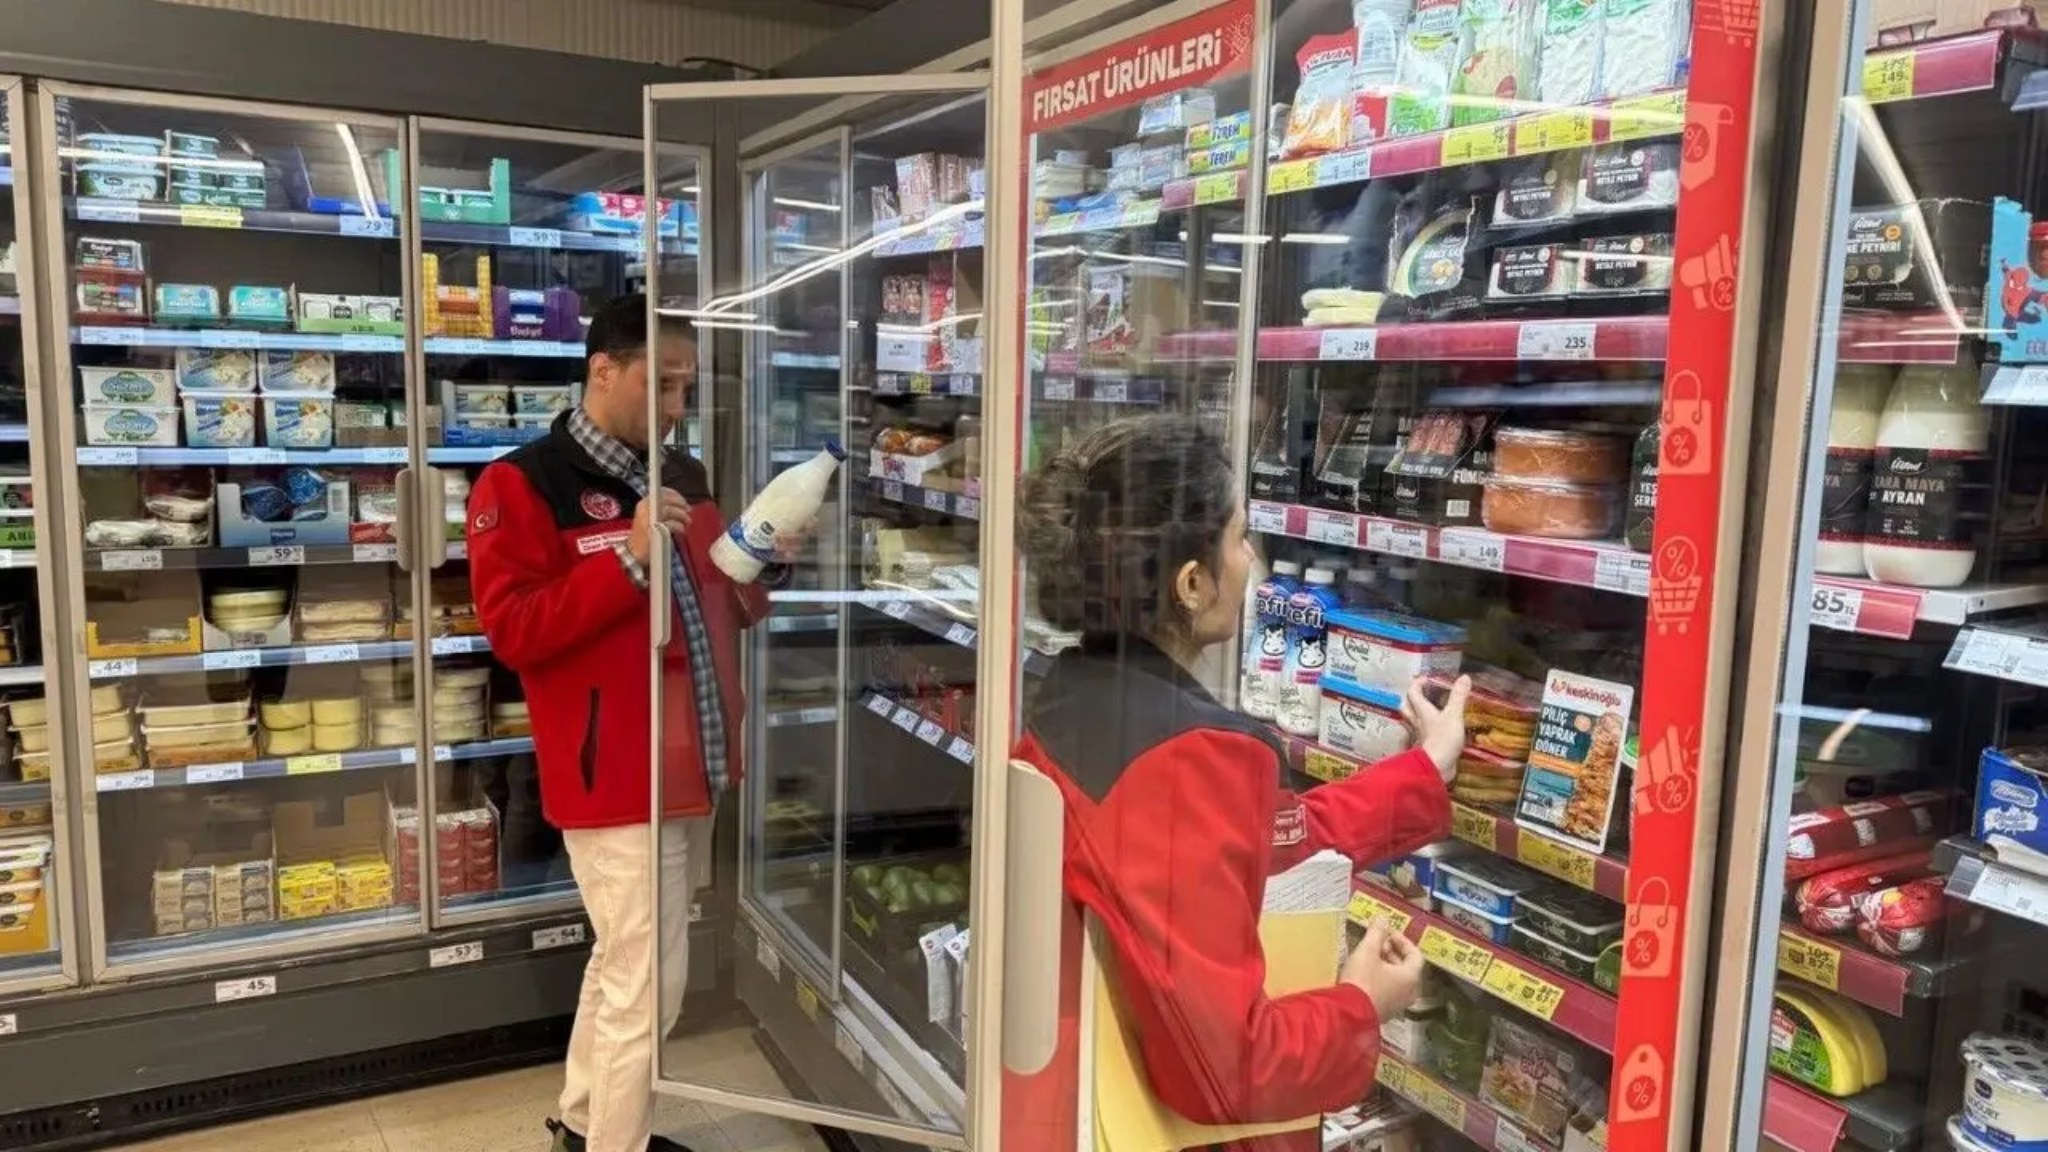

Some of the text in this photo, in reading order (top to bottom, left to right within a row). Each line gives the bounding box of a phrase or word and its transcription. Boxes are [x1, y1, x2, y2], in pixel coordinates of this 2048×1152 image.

[1033, 28, 1222, 122] FIRSAT ÜRÜNLERİ
[1564, 336, 1586, 349] 235
[1905, 478, 1944, 492] MAYA
[1882, 490, 1925, 505] AYRAN
[274, 548, 291, 558] 59
[1479, 546, 1498, 557] 149
[1812, 590, 1844, 613] 85
[103, 662, 121, 670] 44
[1566, 684, 1621, 707] keskinoğlu
[1542, 706, 1568, 726] PİLİÇ
[1540, 721, 1577, 745] YAPRAK
[1535, 737, 1569, 758] DÖNER
[455, 946, 470, 957] 53
[247, 980, 265, 991] 45
